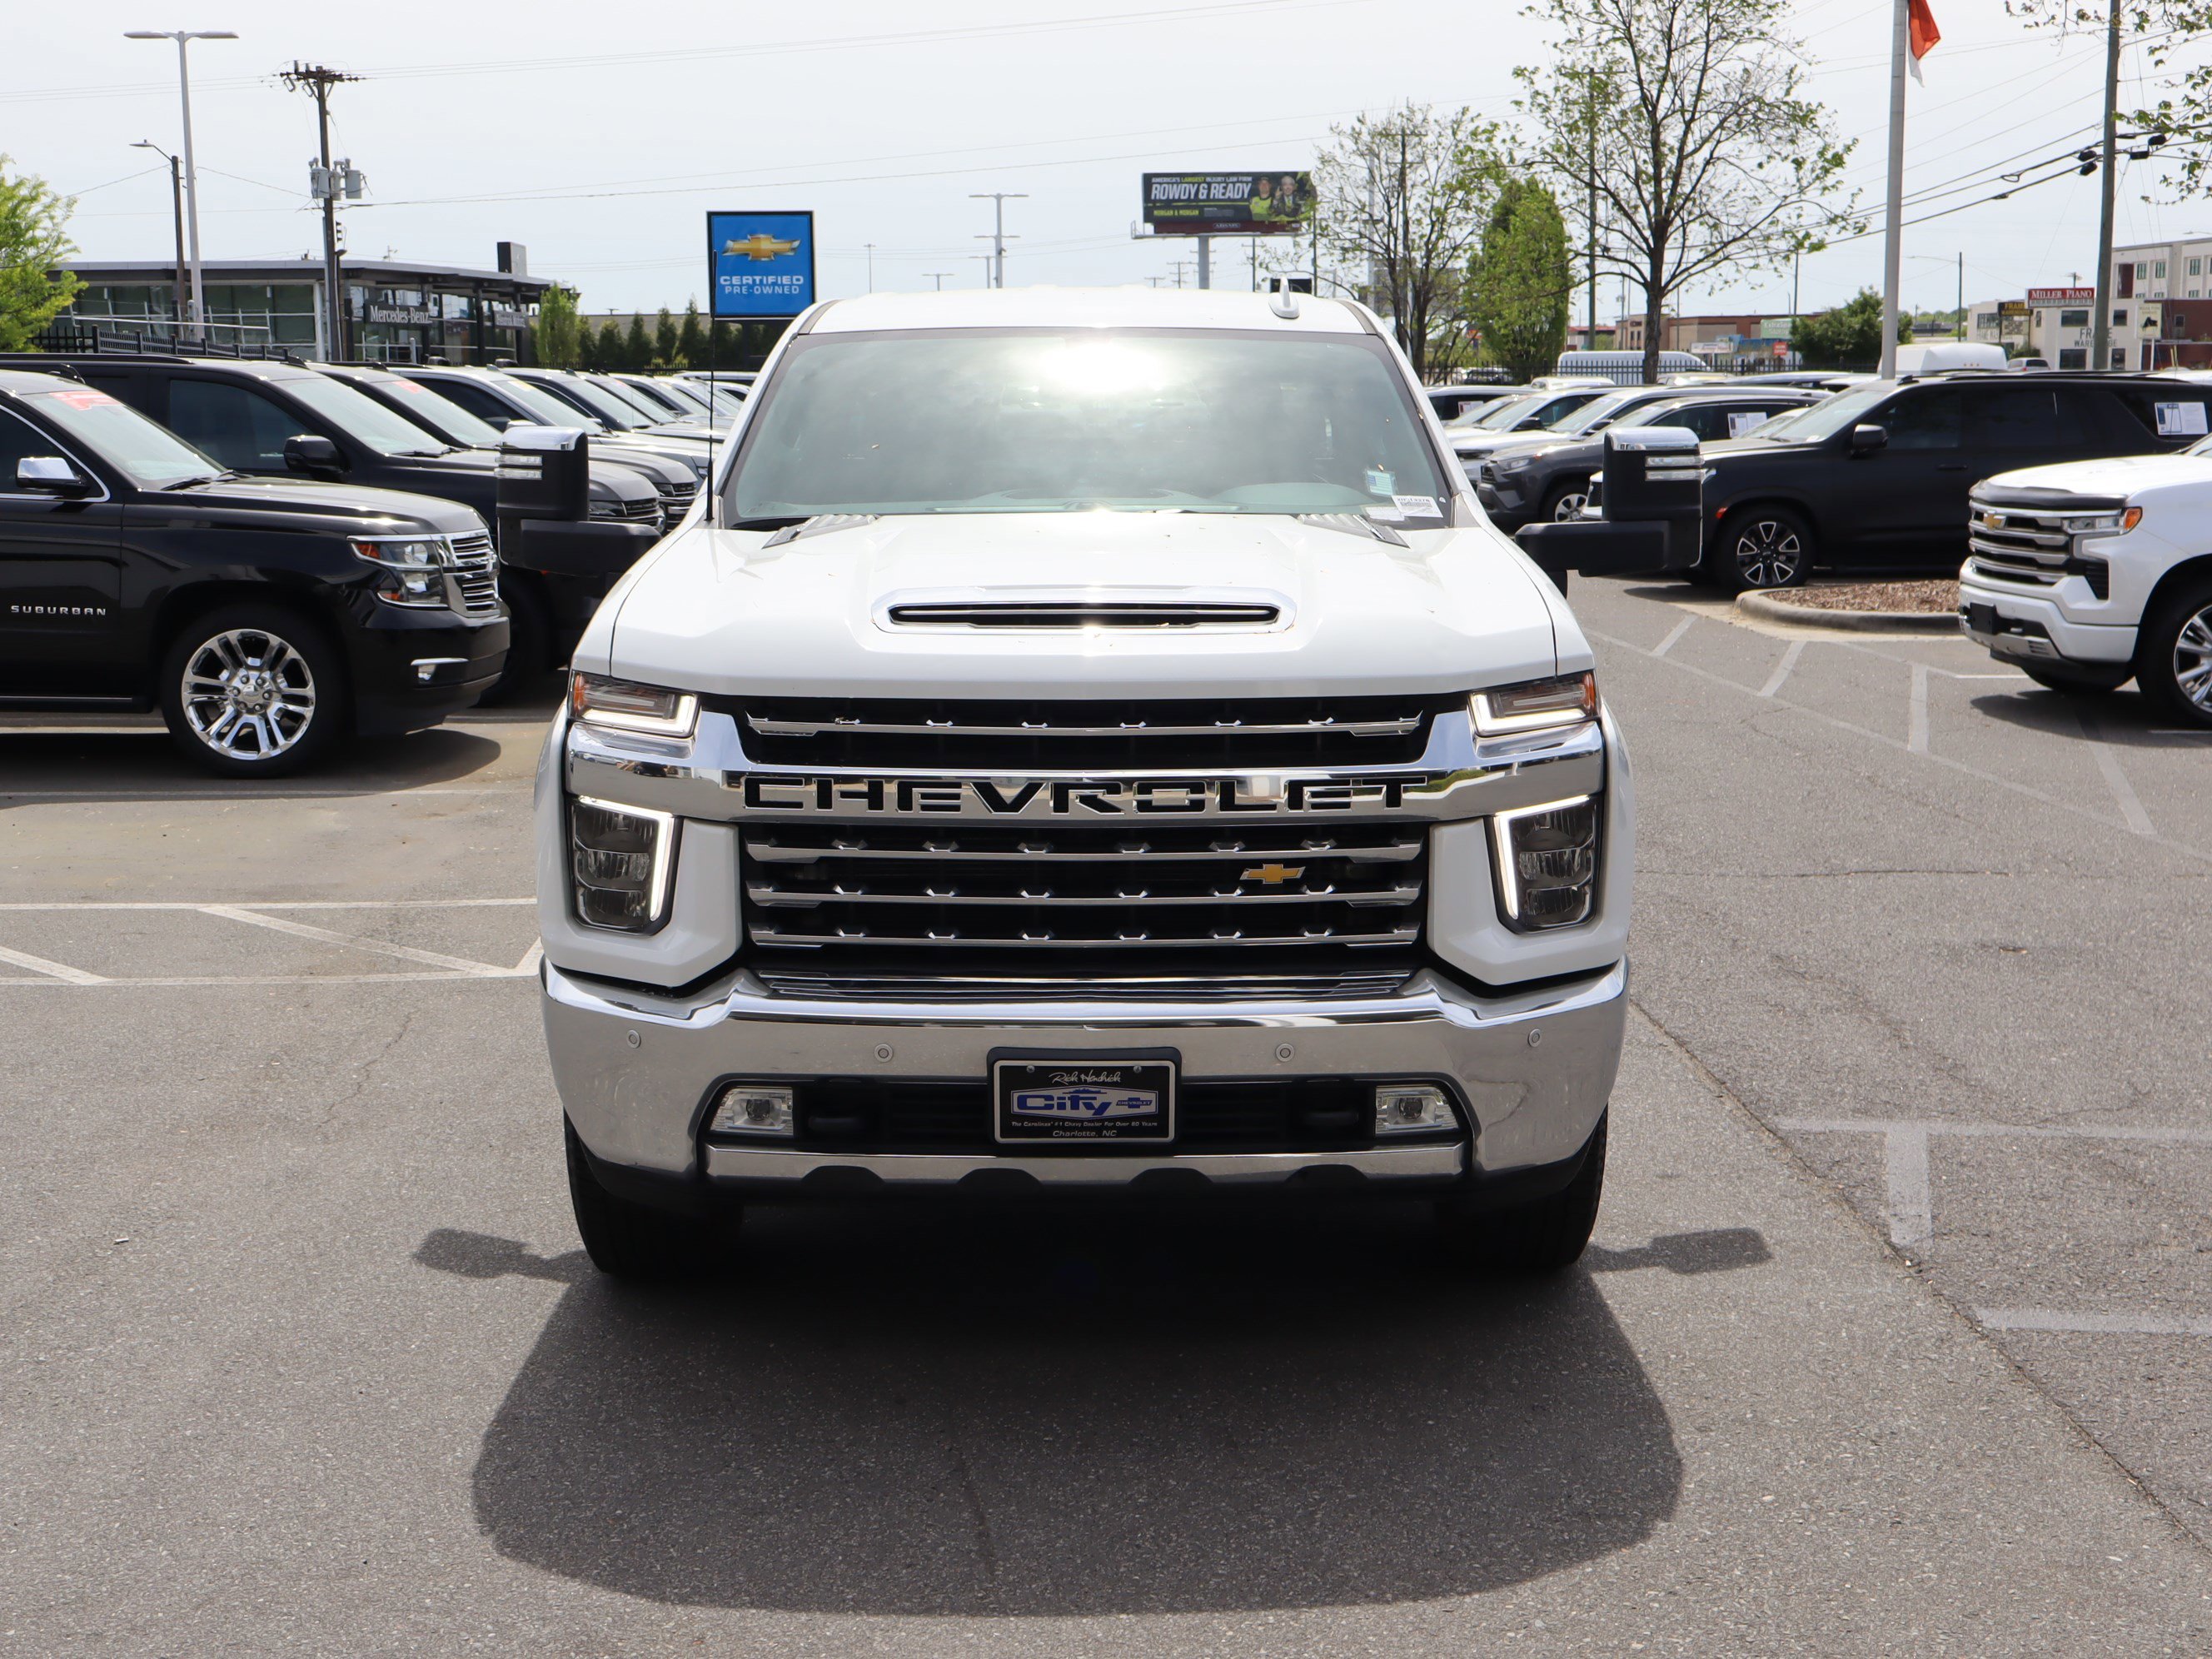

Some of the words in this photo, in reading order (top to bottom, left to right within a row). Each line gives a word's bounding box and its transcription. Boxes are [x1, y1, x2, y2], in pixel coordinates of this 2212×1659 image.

[1151, 183, 1198, 200] ROWDY
[1198, 183, 1208, 200] &
[1210, 182, 1253, 199] READY
[720, 276, 804, 285] CERTIFIED
[725, 286, 800, 294] PRE-OWNED
[2031, 290, 2062, 299] MILLER
[2066, 289, 2092, 298] PIANO
[370, 305, 432, 324] Mercedes-Benz
[2080, 327, 2113, 339] FRE
[11, 605, 107, 615] SUBURBAN
[741, 775, 1428, 815] CHEVROLET
[1049, 1071, 1079, 1085] Rick
[1080, 1069, 1122, 1083] Hendrick
[1017, 1094, 1113, 1116] City
